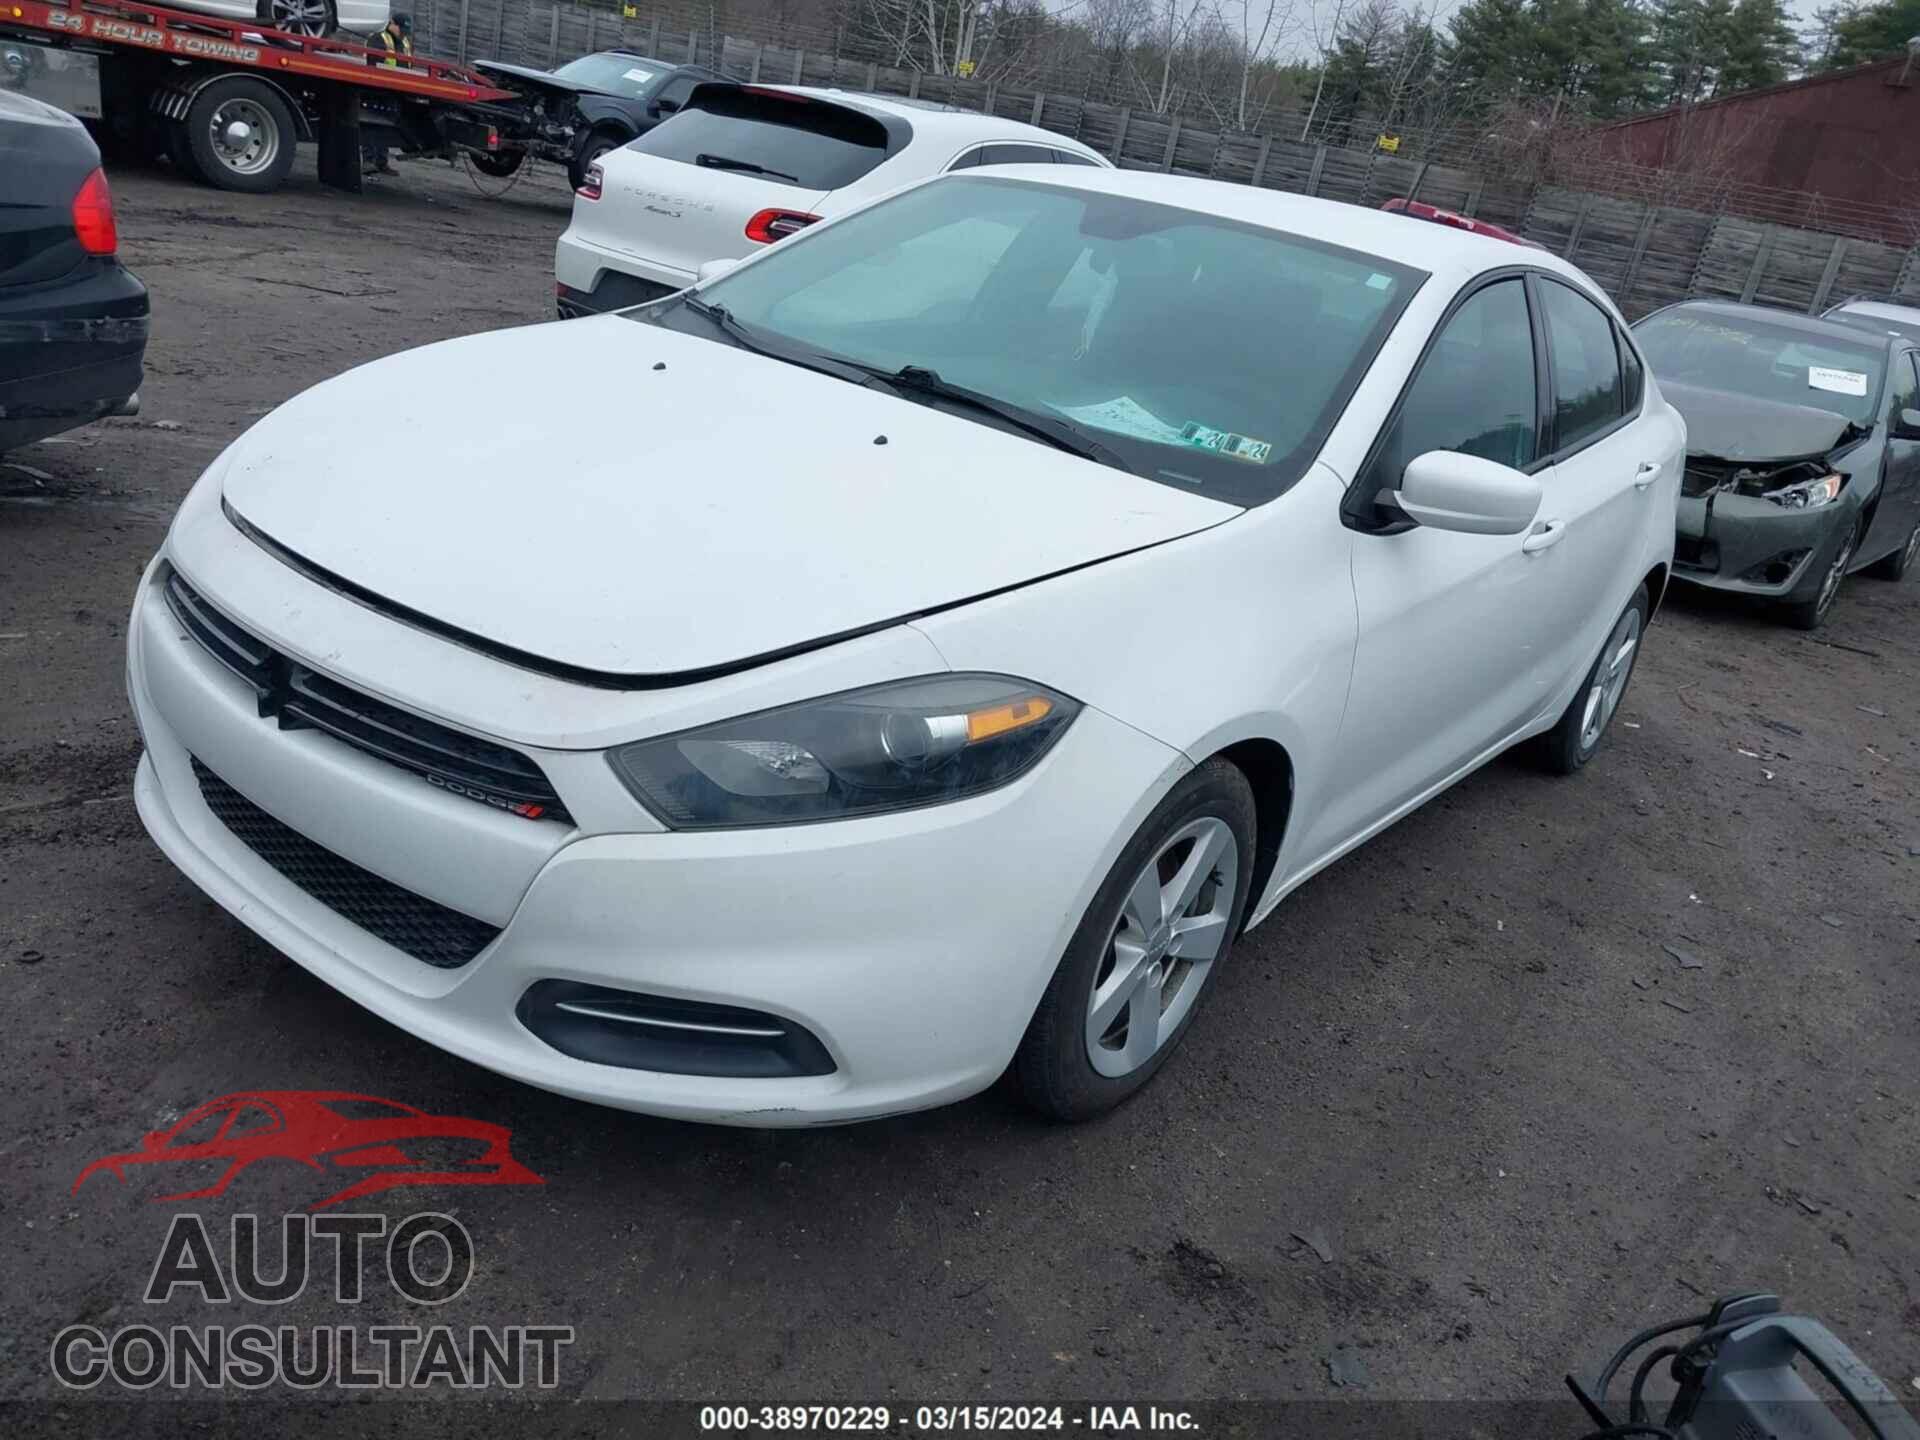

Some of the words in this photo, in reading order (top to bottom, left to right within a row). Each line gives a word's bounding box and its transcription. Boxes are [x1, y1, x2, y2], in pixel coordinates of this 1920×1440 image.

[47, 9, 84, 31] 24
[92, 18, 164, 47] HOUR
[171, 32, 260, 62] TOWING
